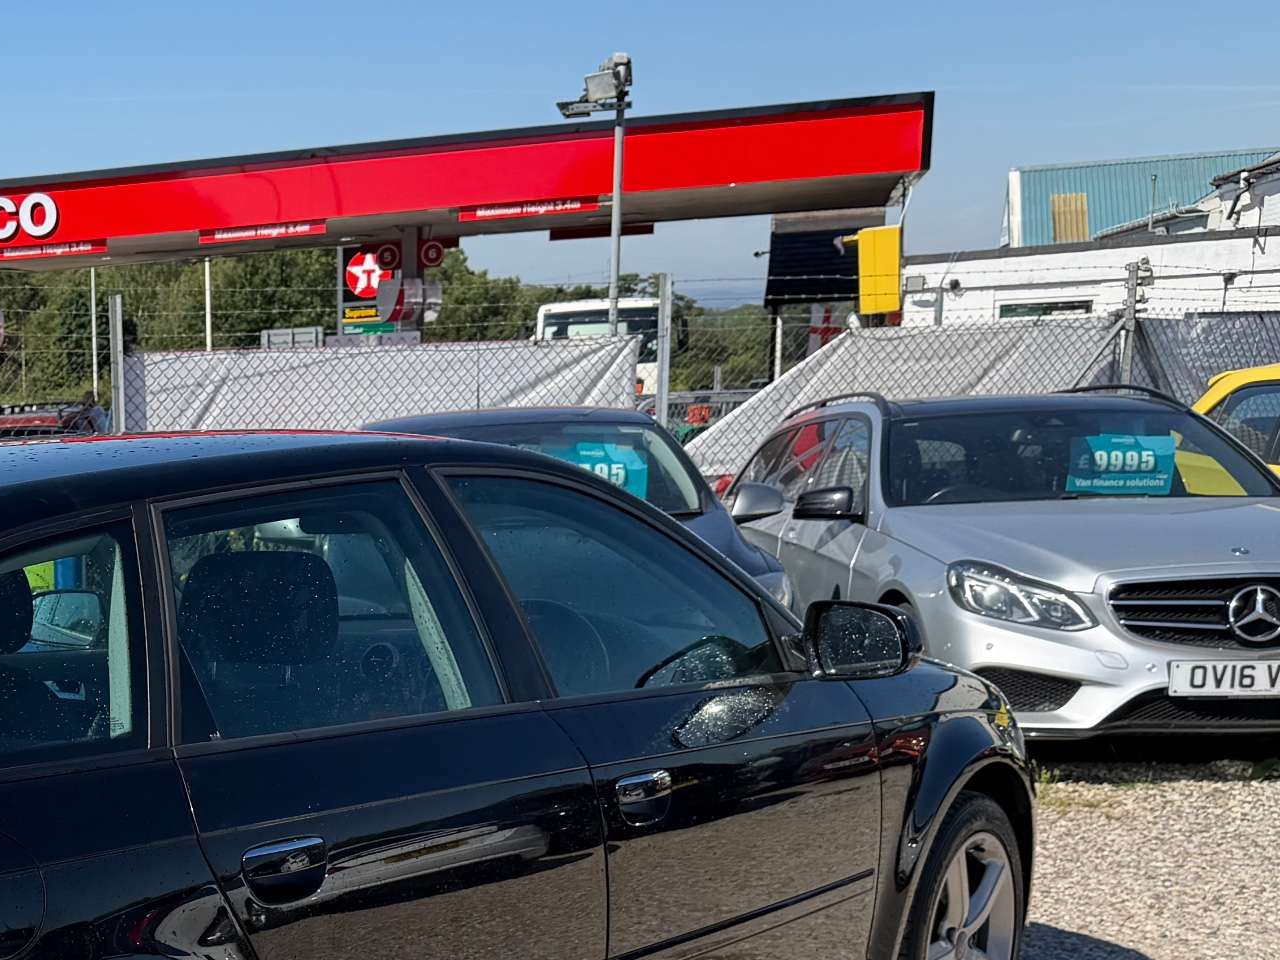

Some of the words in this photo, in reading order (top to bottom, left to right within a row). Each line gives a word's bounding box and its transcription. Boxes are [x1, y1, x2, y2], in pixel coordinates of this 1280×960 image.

[523, 203, 555, 214] Height
[428, 249, 437, 259] 6
[362, 269, 376, 289] T
[1094, 450, 1155, 472] 9995
[578, 463, 625, 487] 95
[1075, 479, 1091, 487] Van
[1092, 478, 1124, 487] finance
[1125, 478, 1164, 487] solutions
[1190, 664, 1256, 689] OV16
